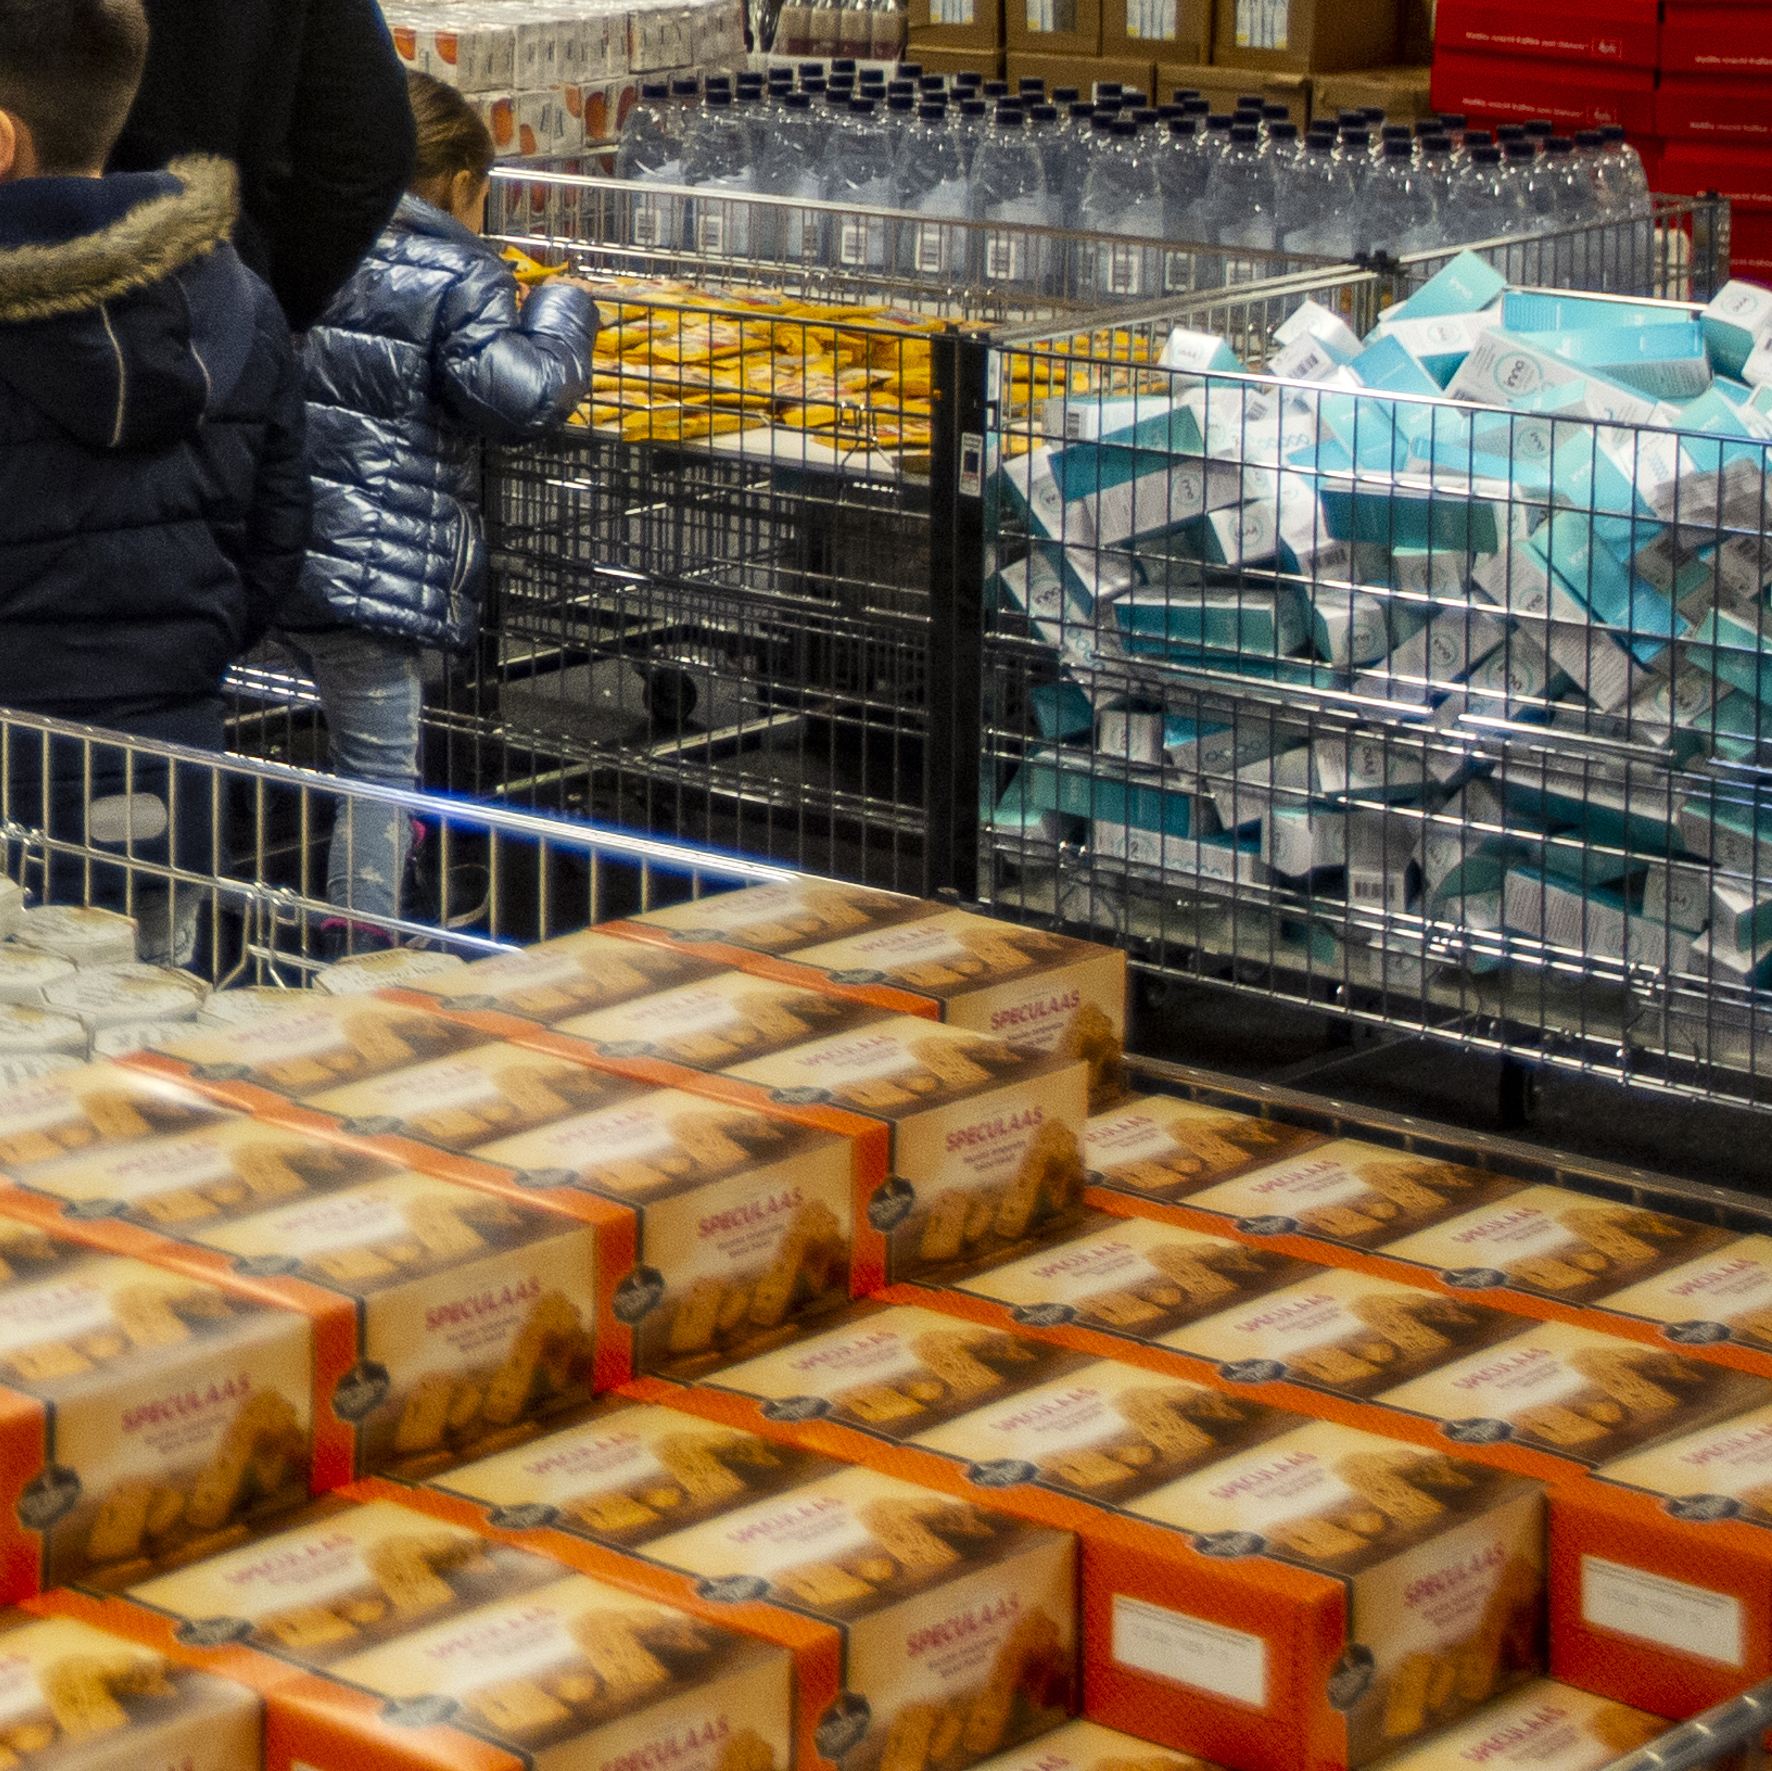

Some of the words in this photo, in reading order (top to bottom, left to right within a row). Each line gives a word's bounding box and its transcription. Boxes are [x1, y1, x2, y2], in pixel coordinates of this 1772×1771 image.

[990, 989, 1081, 1029] SPECULAAS
[946, 1104, 1044, 1152] SPECULAAS
[1256, 1159, 1343, 1195] SPECULAAS
[699, 1186, 803, 1239] SPECULAAS
[1450, 1206, 1544, 1246] SPECULAAS
[1029, 1239, 1133, 1279] SPECULAAS
[1665, 1257, 1761, 1299] SPECULAAS
[424, 1275, 541, 1330] SPECULAAS
[1234, 1293, 1337, 1335] SPECULAAS
[790, 1331, 898, 1370] SPECULAAS
[1450, 1346, 1554, 1391] SPECULAAS
[121, 1372, 252, 1433] SPECULAAS
[990, 1387, 1099, 1432] SPECULAAS
[1209, 1450, 1318, 1500] SPECULAAS
[728, 1496, 845, 1544] SPECULAAS
[1404, 1540, 1508, 1609] SPECULAAS
[905, 1592, 1021, 1659] SPECULAAS
[1460, 1705, 1567, 1764] SPECULAAS
